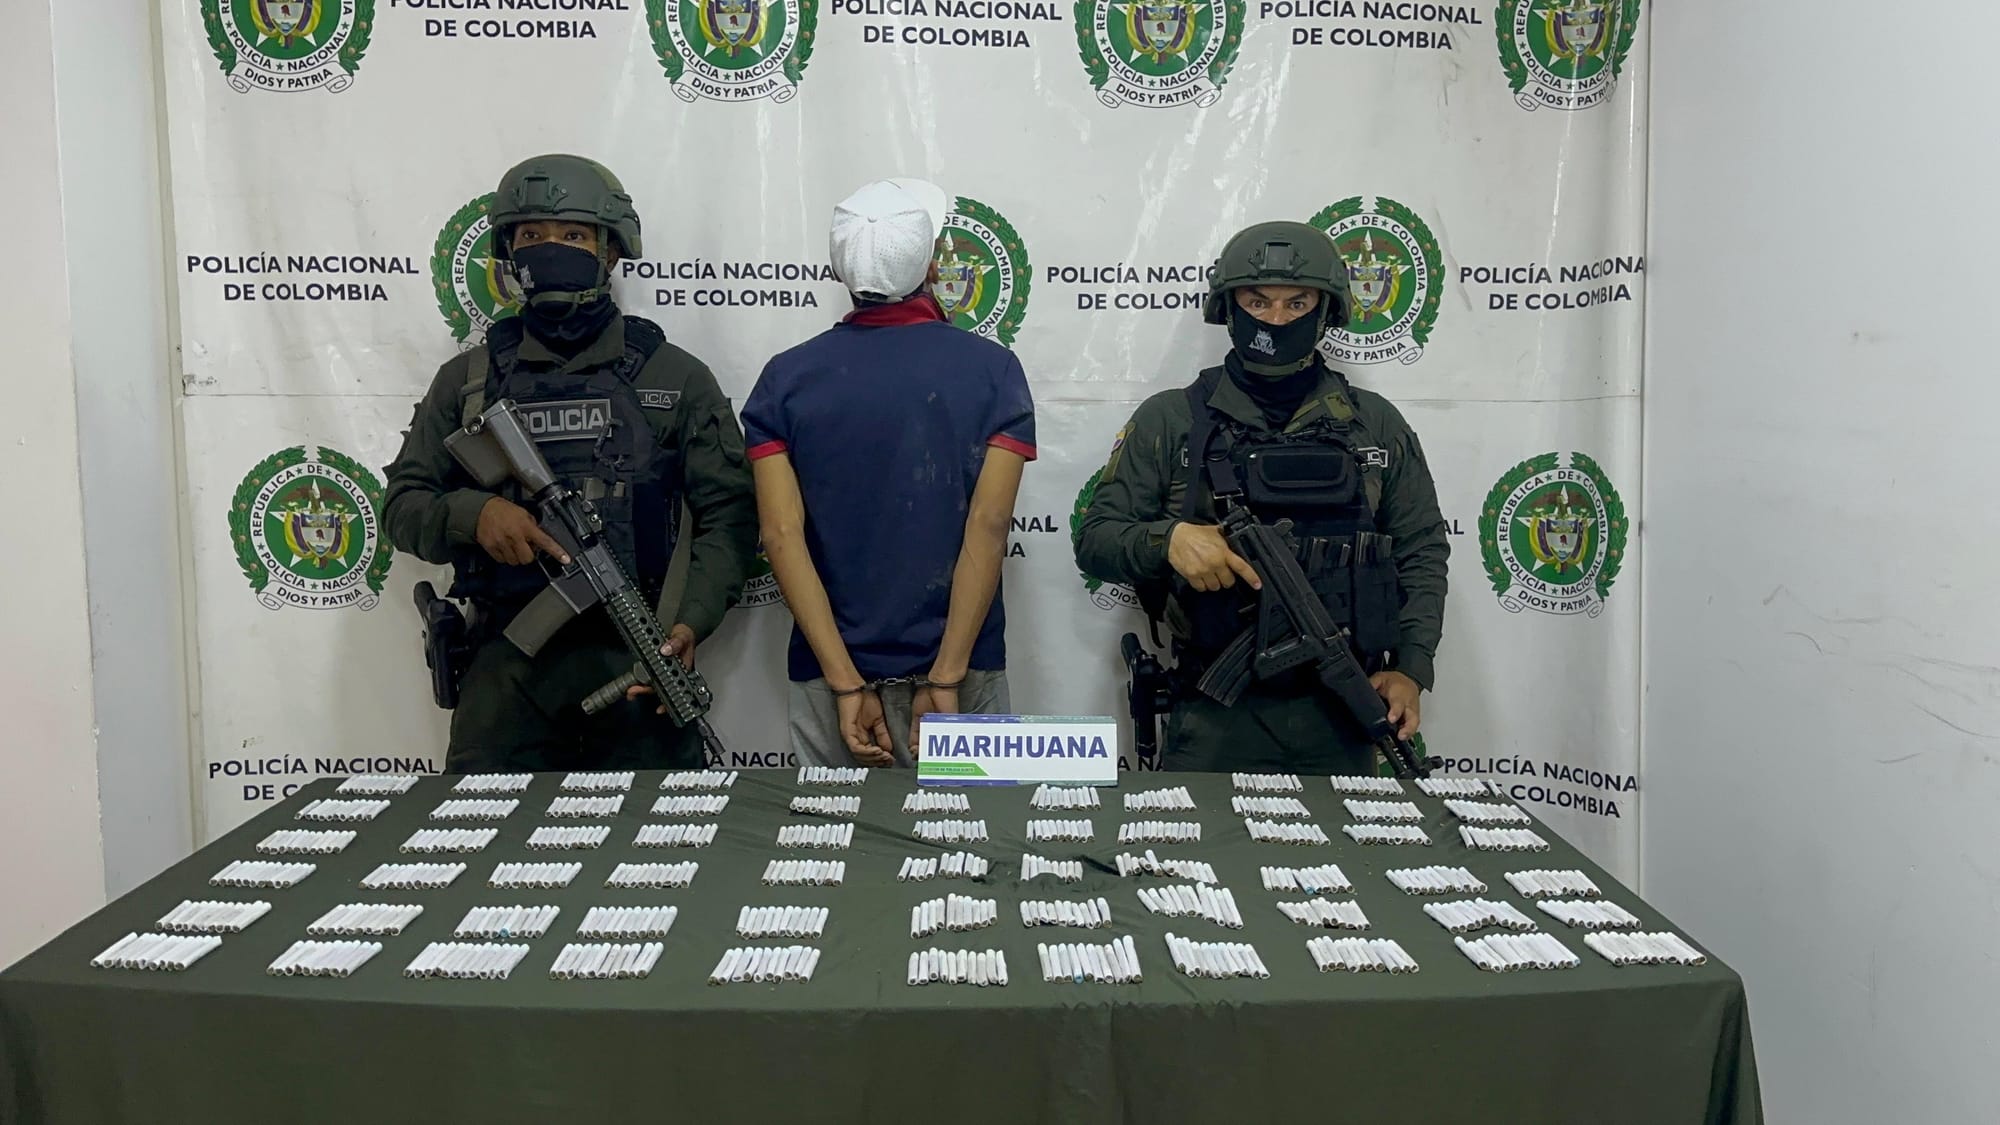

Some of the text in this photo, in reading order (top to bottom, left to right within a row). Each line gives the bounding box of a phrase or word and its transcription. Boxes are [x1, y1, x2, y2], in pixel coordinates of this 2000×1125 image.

[935, 0, 1063, 20] NACIONAL
[1363, 1, 1482, 24] NACIONAL
[425, 19, 597, 38] DE COLOMBIA
[863, 25, 1031, 48] DE COLOMBIA
[1292, 28, 1453, 50] DE COLOMBIA
[287, 31, 347, 71] NACIONAL
[734, 39, 793, 80] NACIONAL
[1160, 46, 1219, 87] NACIONAL
[288, 69, 333, 88] PATRIA
[734, 79, 778, 98] PATRIA
[1159, 84, 1203, 104] PATRIA
[1577, 81, 1610, 106] PATRIA
[187, 252, 419, 274] POLICÍA NACIONAL
[973, 224, 1011, 291] COLOMBIA
[1362, 216, 1426, 291] DE COLOMBIA
[622, 258, 835, 281] POLICÍA NACIONA
[1047, 263, 1140, 283] POLICÍA
[1460, 256, 1645, 283] POLICÍA NACIONA
[224, 284, 388, 301] DE COLOMBIA
[656, 289, 818, 307] DE COLOMBIA
[1078, 293, 1208, 310] DE COLOM
[1489, 284, 1632, 310] DE COLOMBIA
[1364, 305, 1420, 345] NACIONAL
[1364, 342, 1406, 361] PATRIA
[307, 464, 323, 474] DE
[335, 473, 375, 539] COLOMBIA
[1558, 470, 1574, 480] DE
[1583, 478, 1607, 543] COLOMBIA
[322, 554, 372, 590] NACIONAL
[1562, 559, 1602, 596] NACIONAL
[322, 588, 362, 606] PATRIA
[1110, 588, 1138, 605] DIOS
[1561, 594, 1592, 611] PATRIA
[927, 734, 1108, 758] MARIHUANA
[209, 754, 441, 778] POLICÍA NACIONAL
[1445, 755, 1638, 792] POLICÍA NACIONA
[244, 785, 275, 800] DE
[1510, 784, 1620, 818] COLOMBIA
